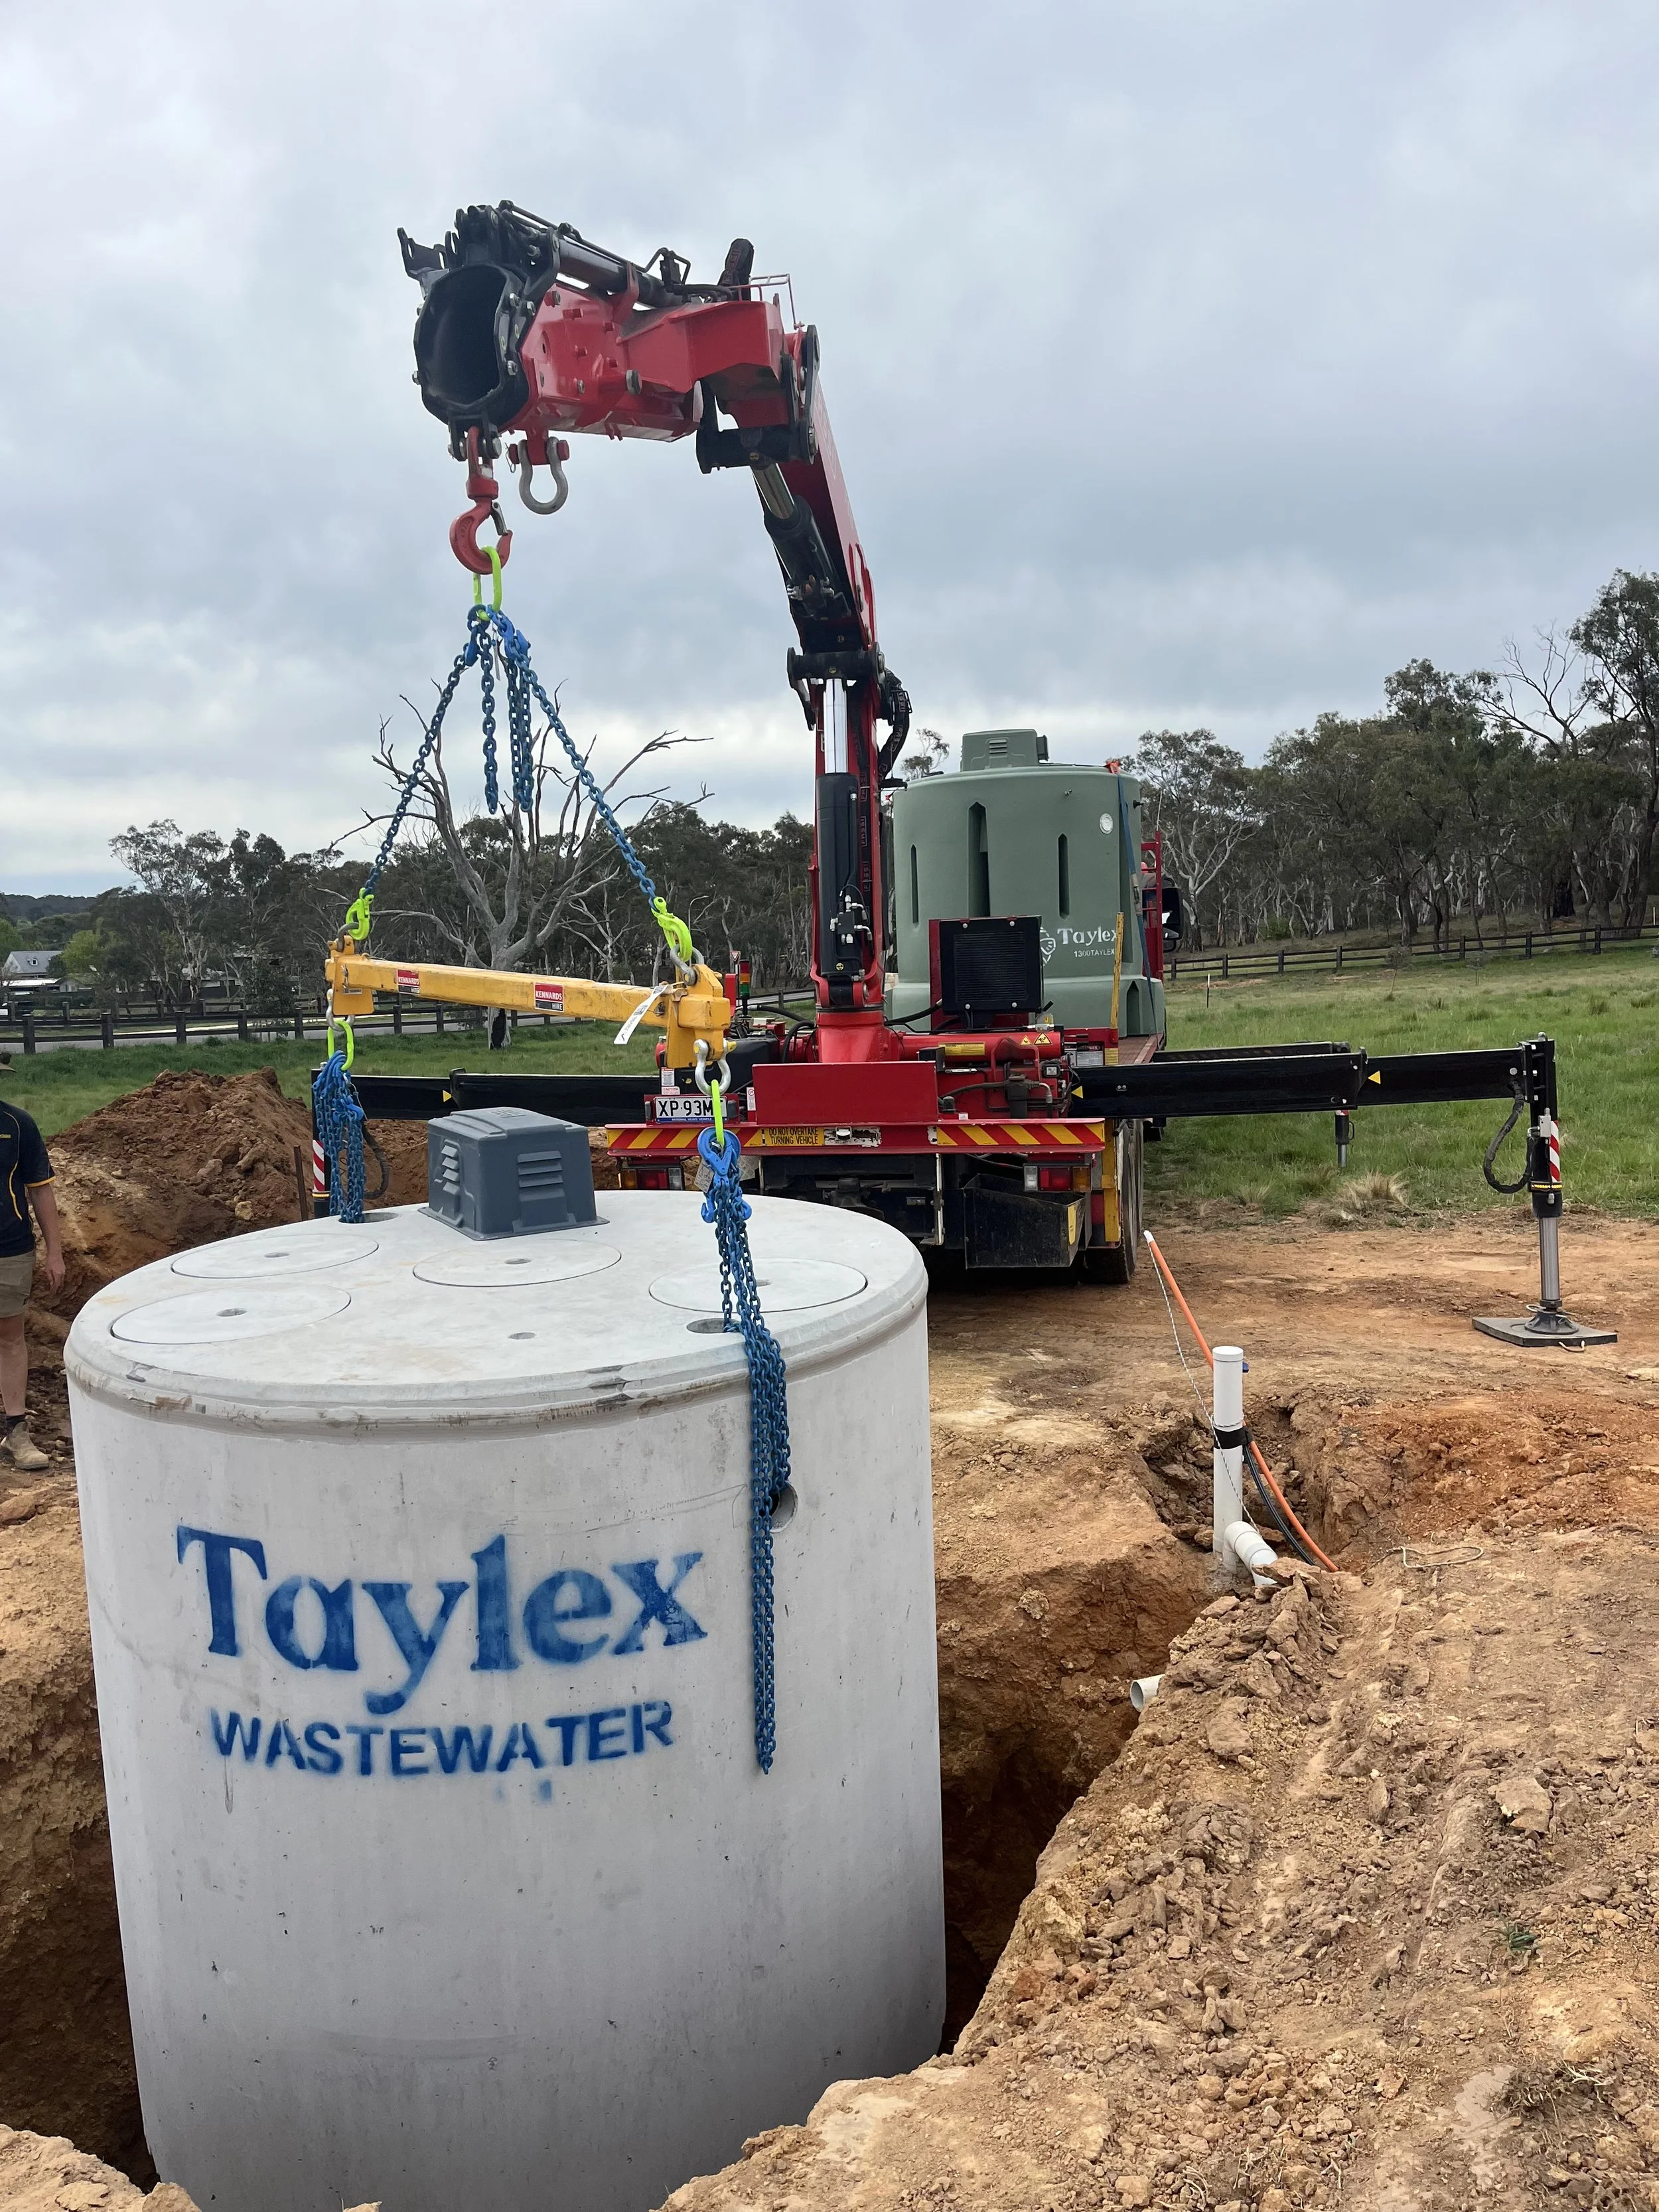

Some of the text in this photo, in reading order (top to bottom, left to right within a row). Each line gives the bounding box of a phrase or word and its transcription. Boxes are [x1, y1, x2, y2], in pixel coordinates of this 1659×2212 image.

[536, 990, 563, 1000] KENNARDS
[796, 1136, 818, 1144] VEHICLE
[177, 1526, 707, 1716] Taylex
[212, 1701, 673, 1777] WASTEWATER
